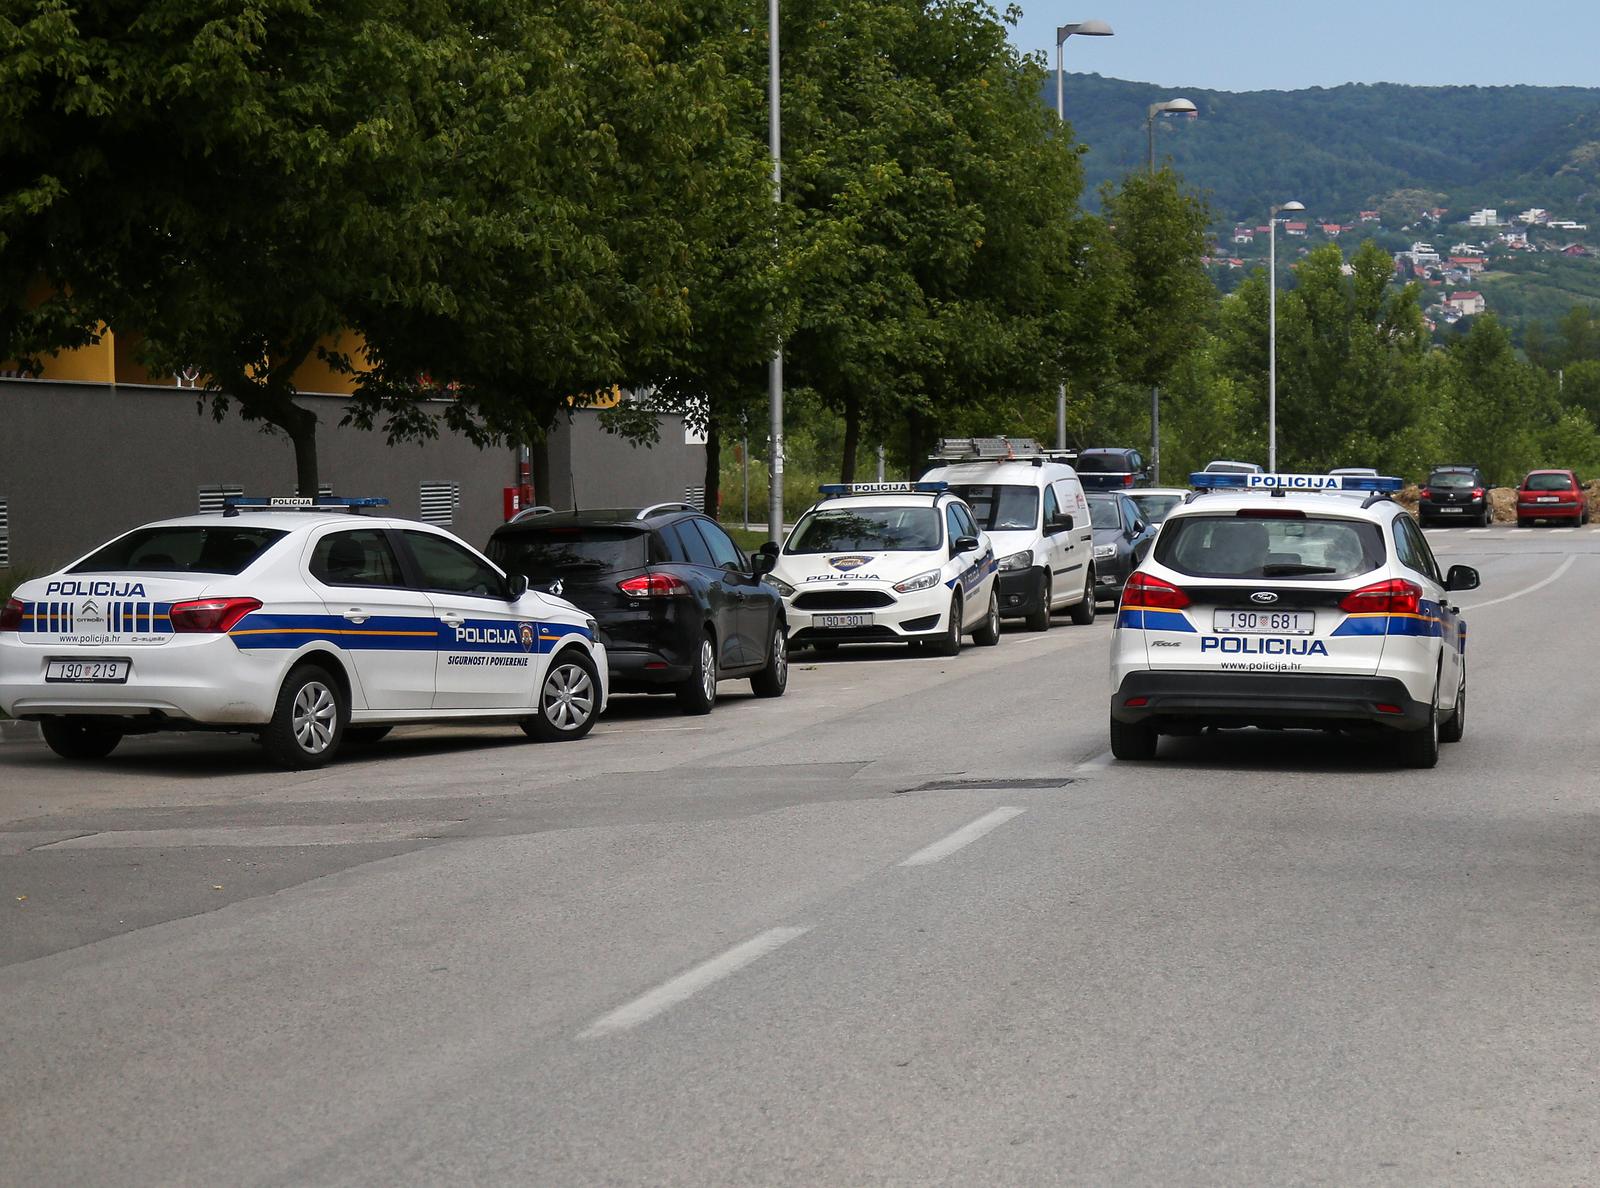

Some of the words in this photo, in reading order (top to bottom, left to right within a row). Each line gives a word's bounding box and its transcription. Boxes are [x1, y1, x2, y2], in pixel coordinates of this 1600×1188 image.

[1252, 476, 1338, 488] POLICIJA
[806, 573, 880, 581] POLICIJA
[46, 582, 146, 597] POLICIJA
[822, 615, 838, 626] 190
[847, 615, 864, 625] 301
[1230, 613, 1257, 628] 190
[1271, 614, 1298, 629] 681
[59, 635, 121, 644] www.policija.hr
[456, 628, 518, 644] POLICIJA
[1201, 637, 1329, 657] POLICIJA
[448, 656, 486, 666] SIGURNOST
[490, 657, 528, 667] POVJERENJE
[1221, 662, 1302, 672] www.policija.hr
[60, 664, 82, 678] 190
[92, 664, 117, 678] 219
